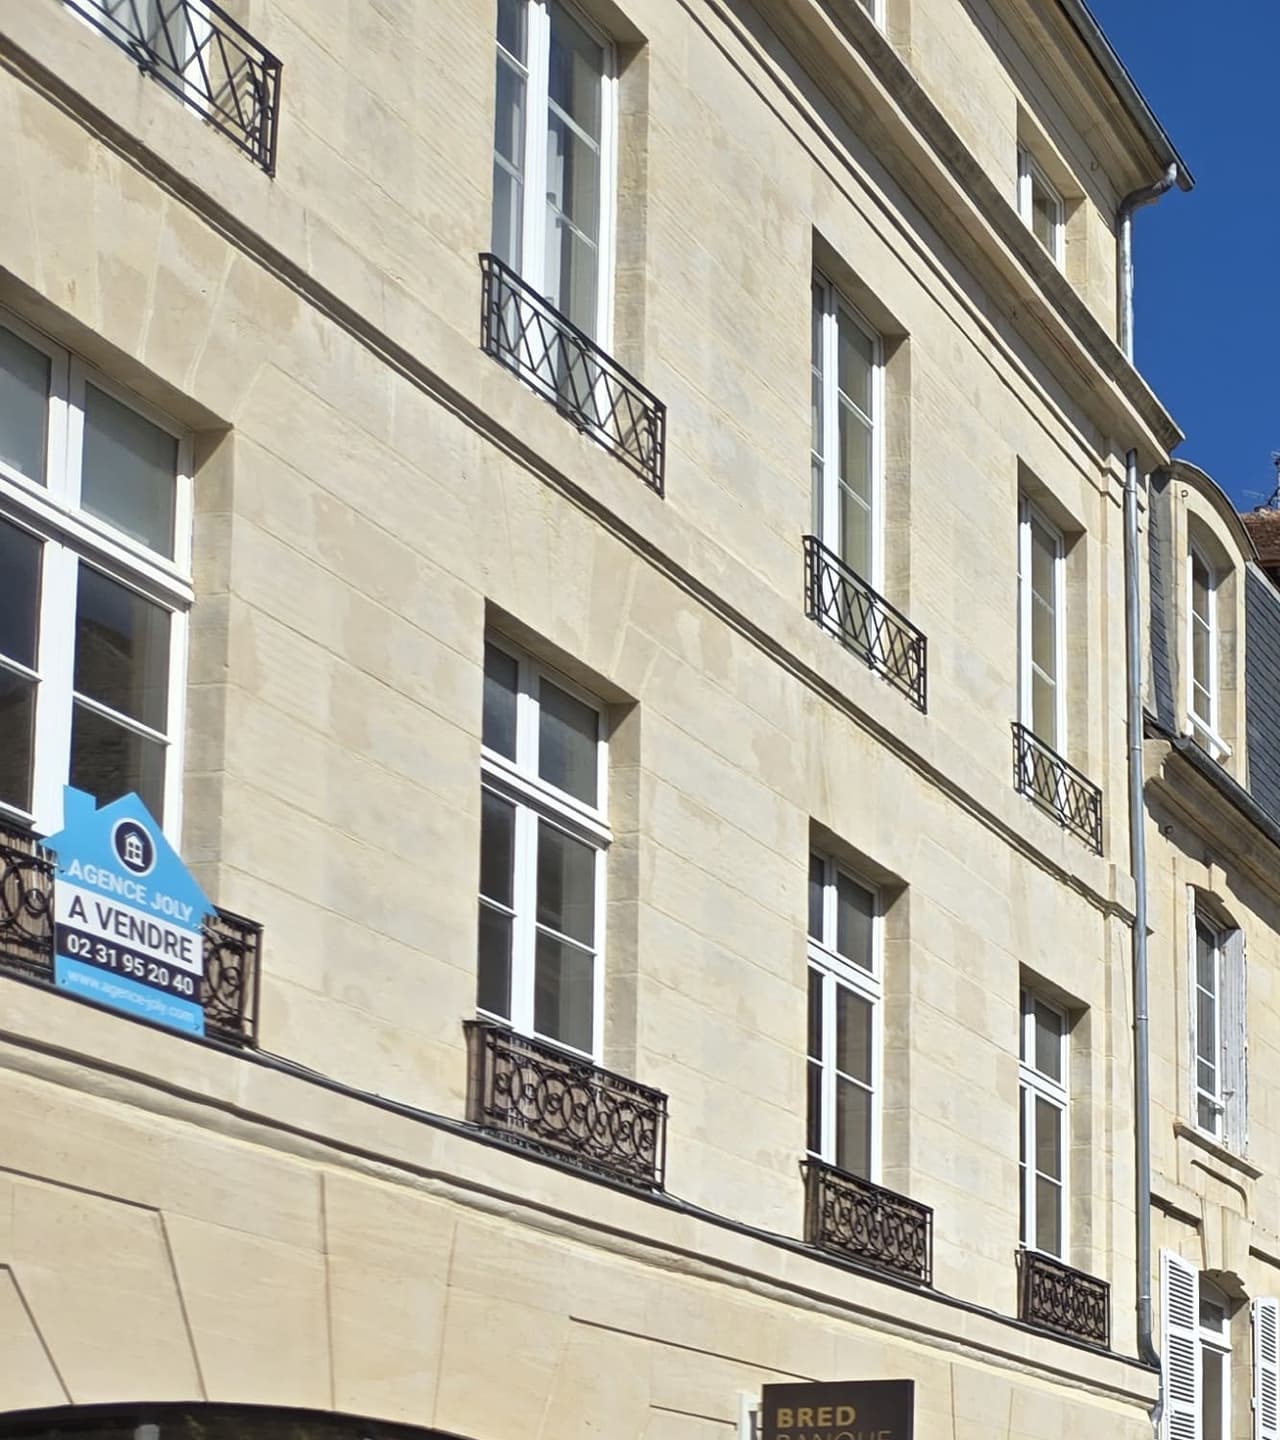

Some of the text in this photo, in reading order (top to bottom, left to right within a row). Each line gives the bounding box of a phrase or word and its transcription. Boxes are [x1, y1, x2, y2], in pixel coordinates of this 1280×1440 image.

[67, 859, 194, 921] AGENCE JOLY
[67, 895, 194, 965] A VENDRE
[67, 934, 194, 996] 02 31 95 20 40
[777, 1405, 857, 1429] BRED
